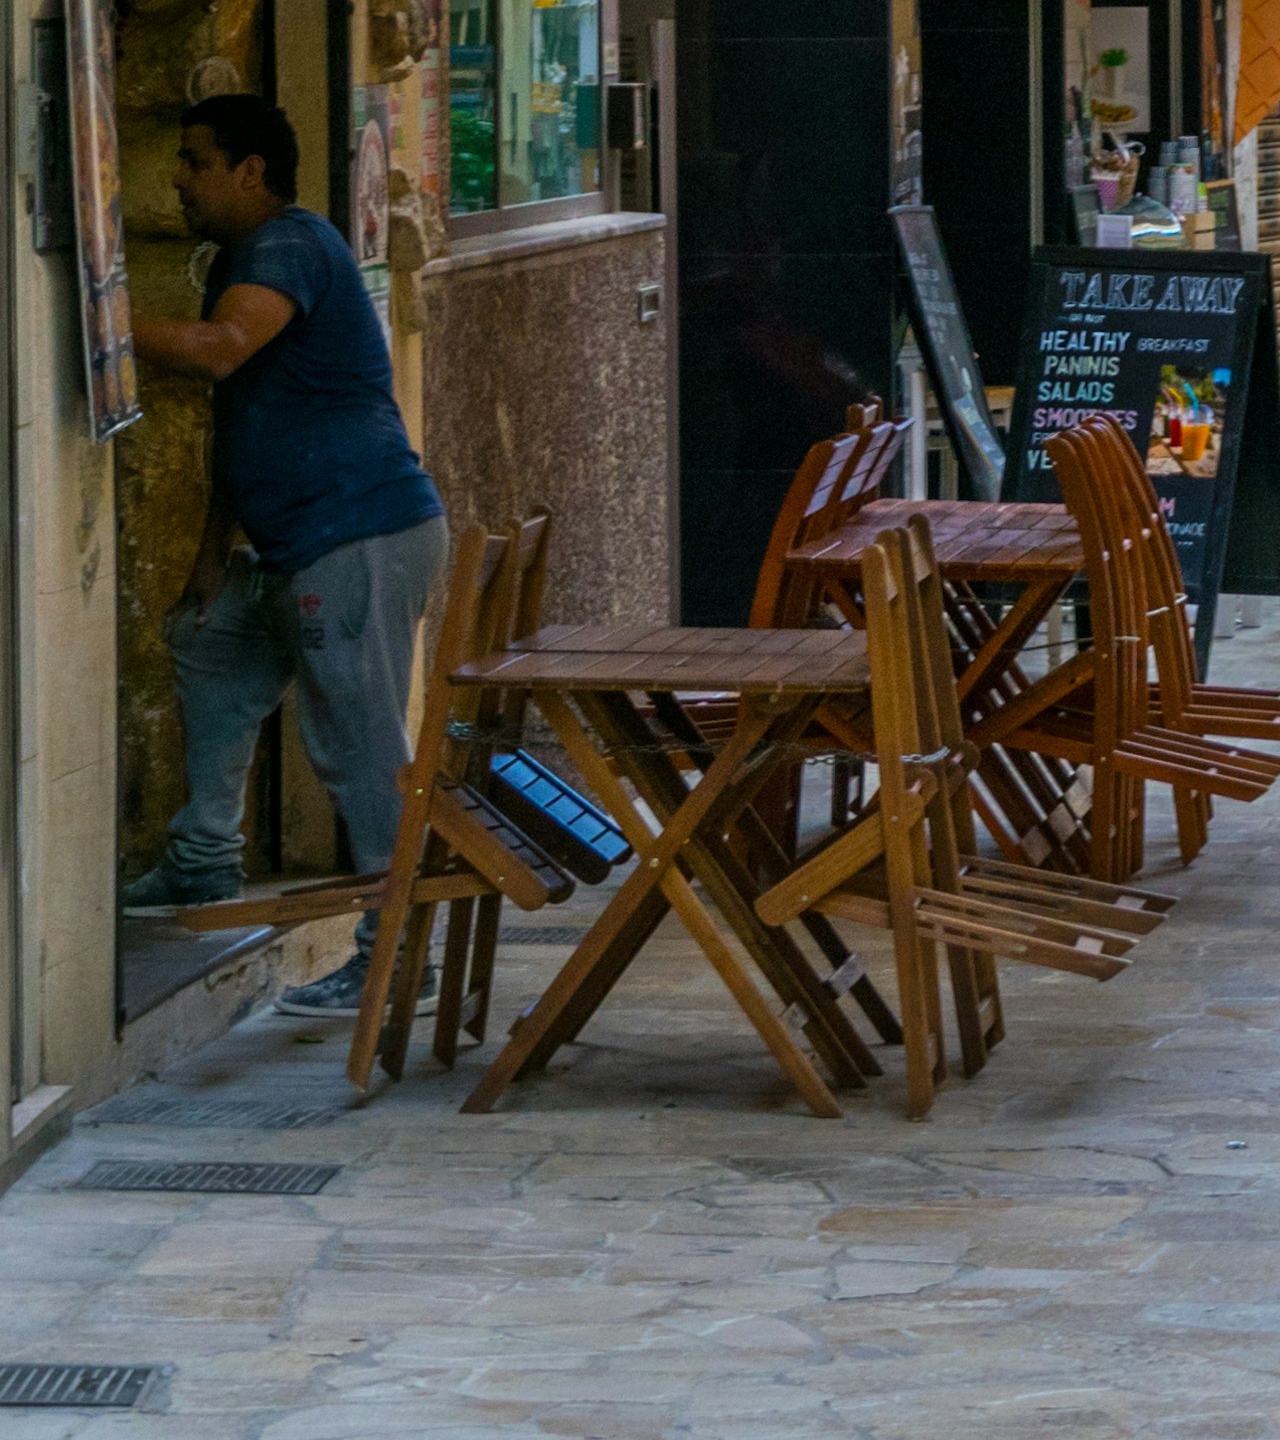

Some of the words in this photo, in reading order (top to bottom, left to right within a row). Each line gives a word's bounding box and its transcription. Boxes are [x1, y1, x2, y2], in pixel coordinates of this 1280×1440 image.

[1060, 271, 1155, 310] TAKE
[1155, 275, 1246, 315] AWAY
[1039, 330, 1132, 353] HEALTHY
[1136, 337, 1211, 353] BREAKFAST
[1037, 381, 1116, 403] SALADS
[1032, 407, 1139, 430] SMOOES
